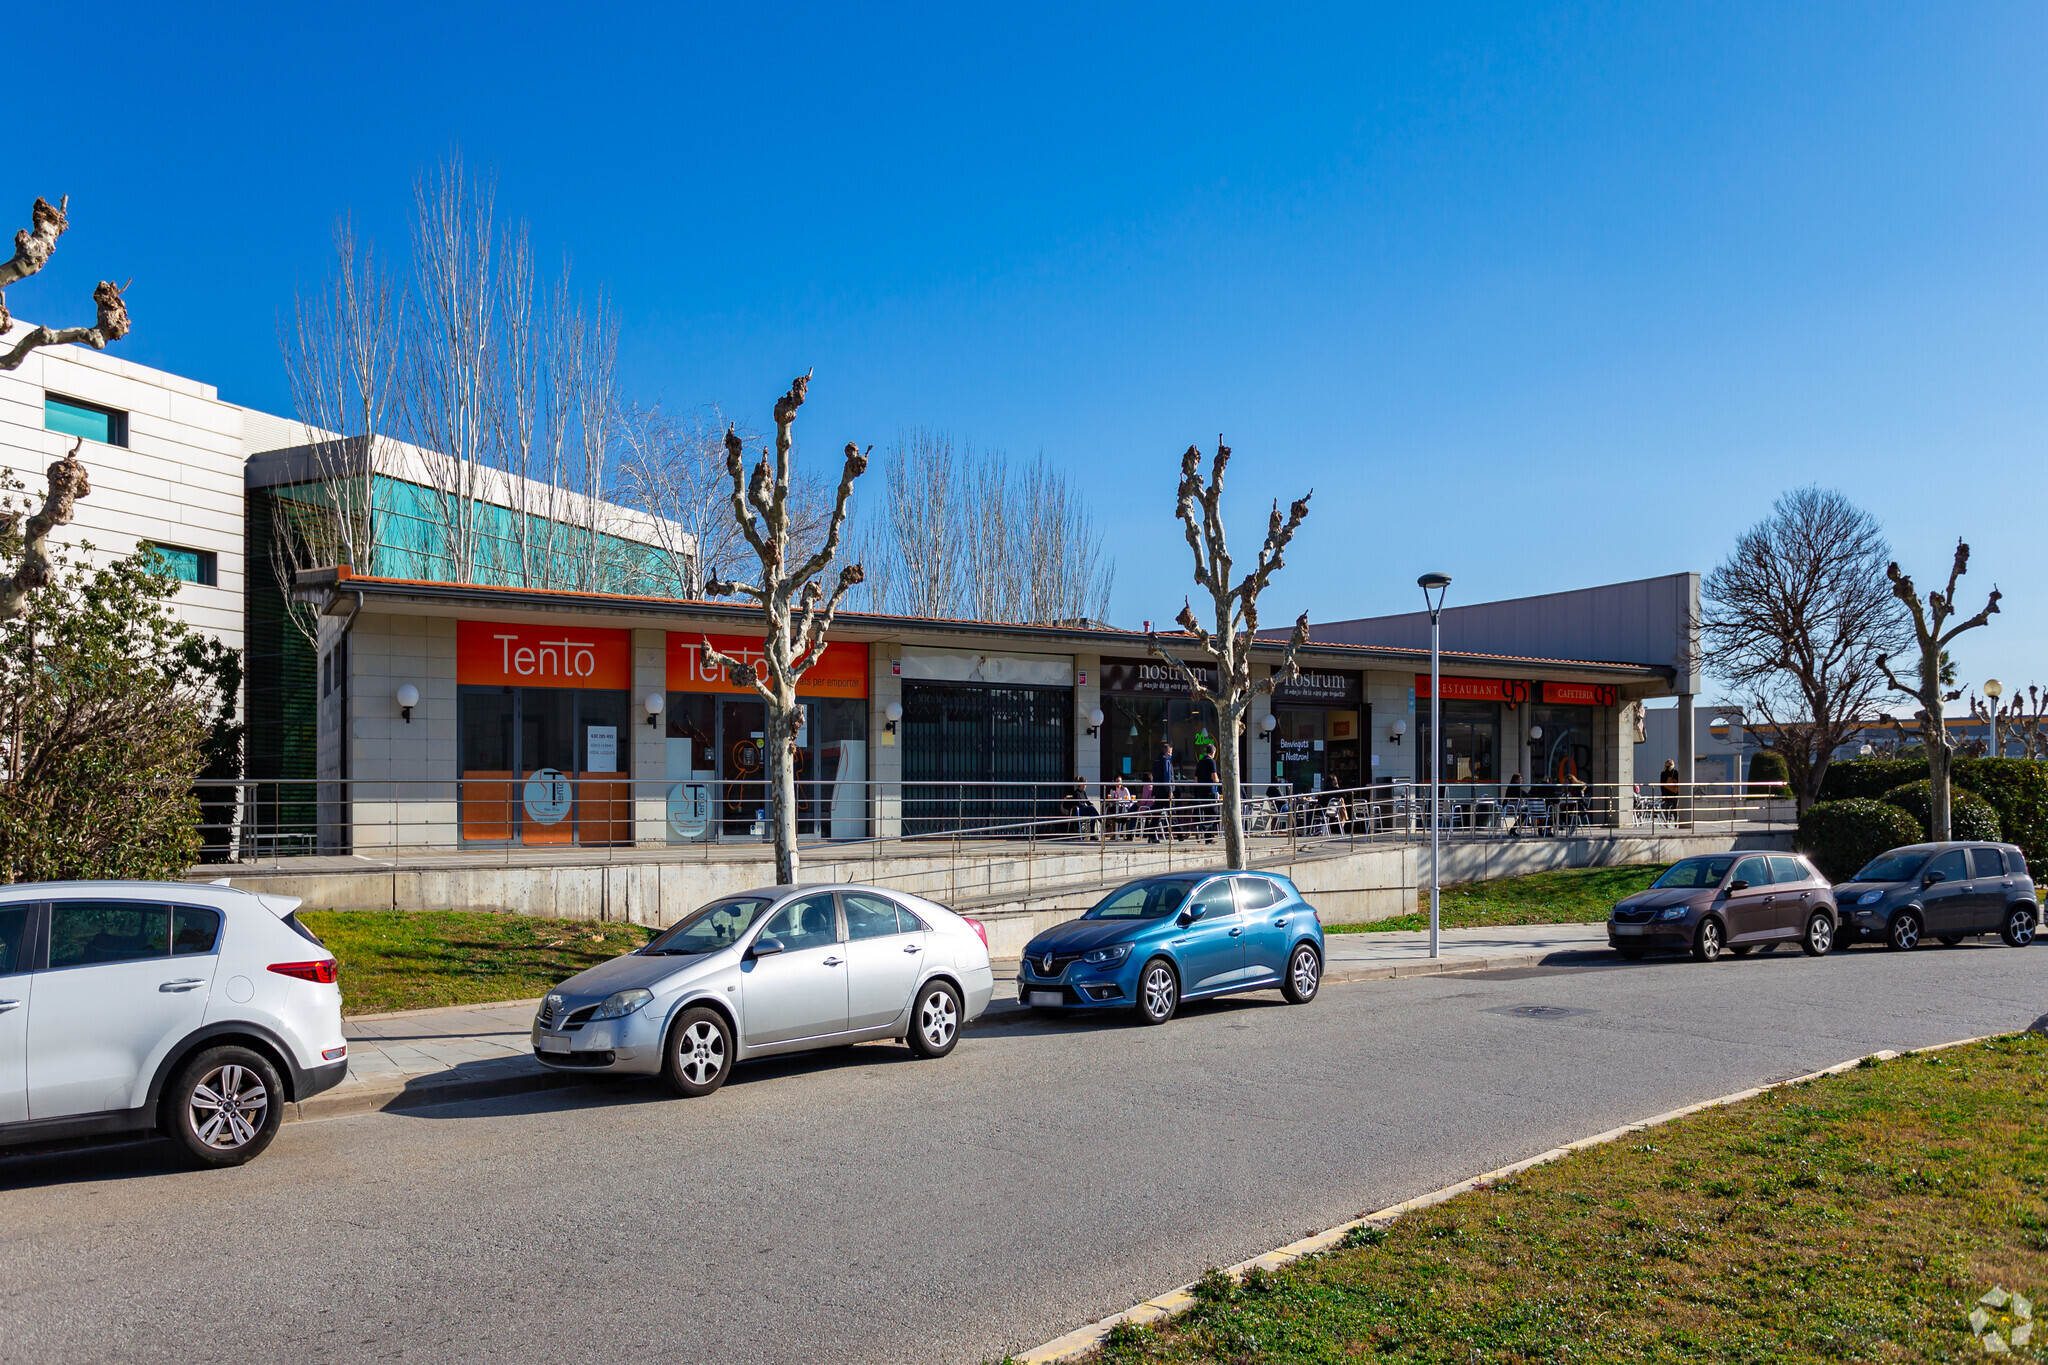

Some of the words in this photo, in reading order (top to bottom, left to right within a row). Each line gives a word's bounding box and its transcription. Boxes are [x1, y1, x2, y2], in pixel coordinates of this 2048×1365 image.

[493, 634, 595, 677] Tento
[813, 678, 825, 689] per
[827, 678, 860, 689] emportar
[1284, 670, 1346, 689] nostrum
[1438, 683, 1498, 695] ESTAURANT
[1558, 689, 1594, 700] CAFETERIA
[1280, 738, 1310, 752] Benvinguts
